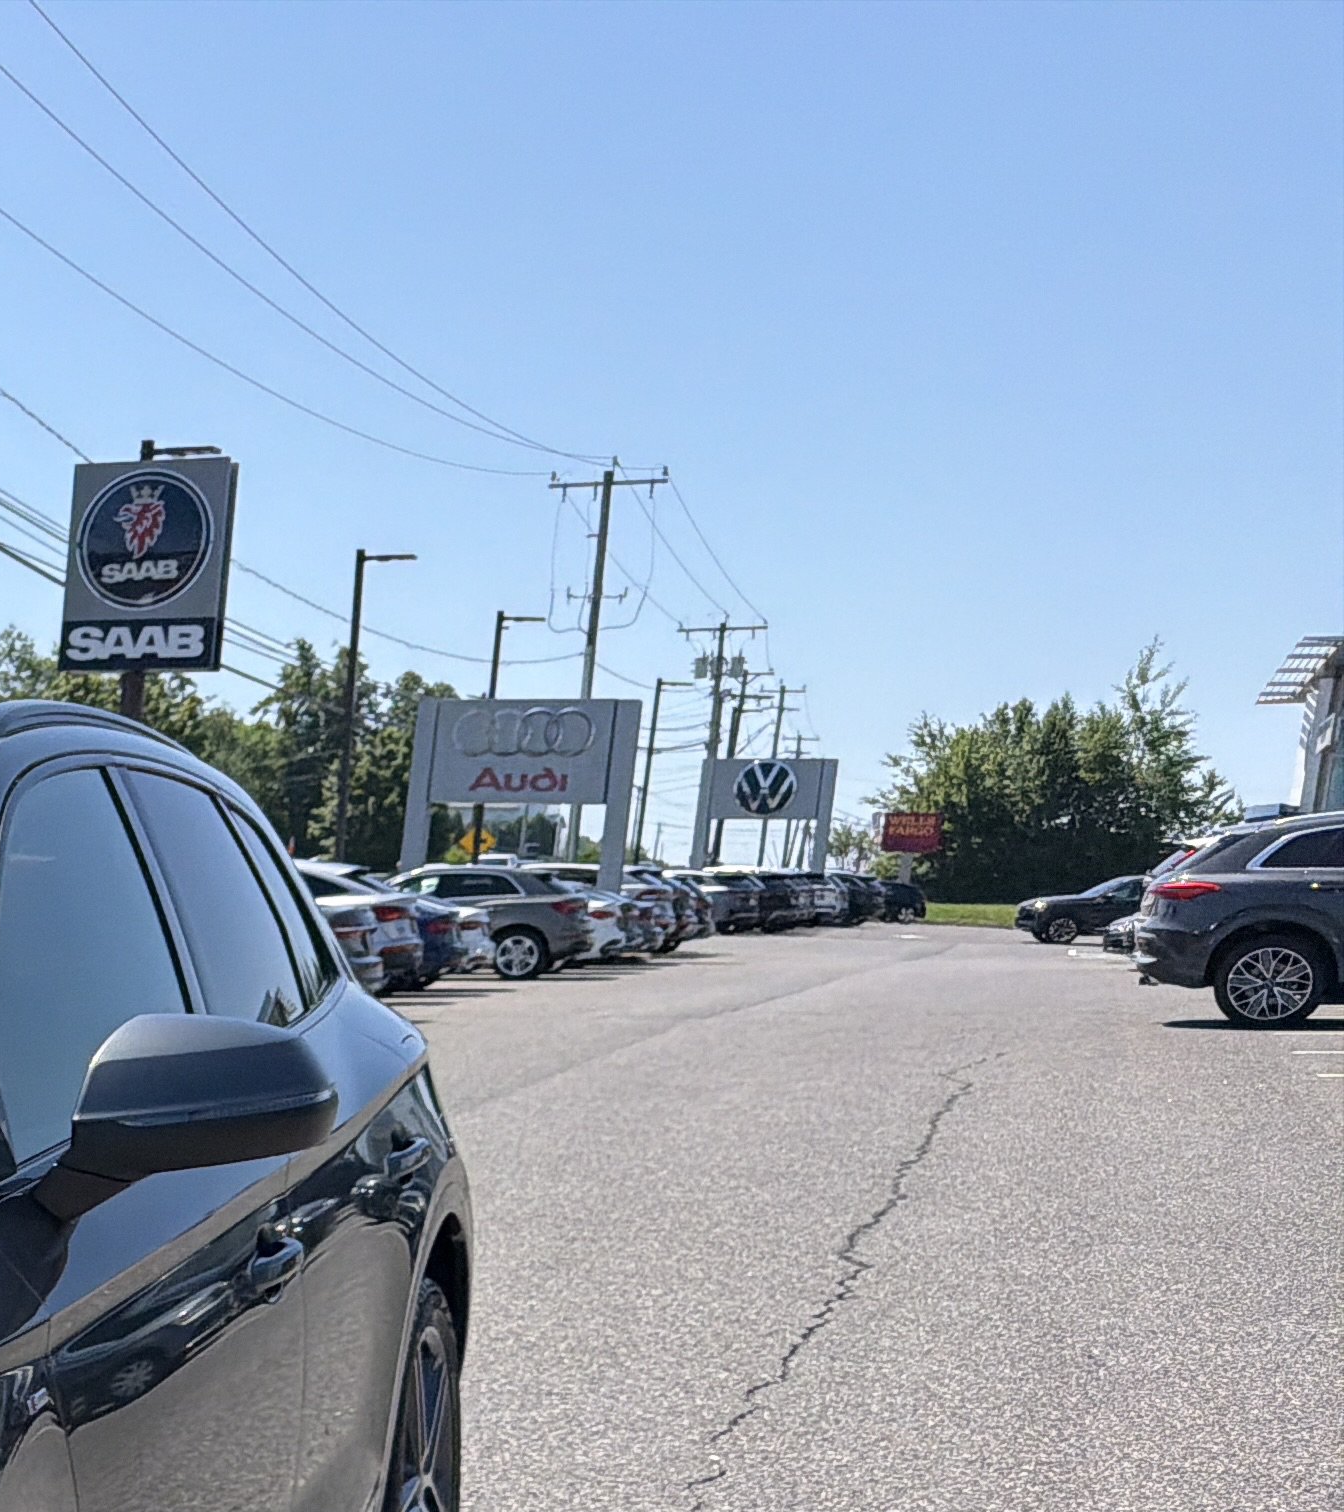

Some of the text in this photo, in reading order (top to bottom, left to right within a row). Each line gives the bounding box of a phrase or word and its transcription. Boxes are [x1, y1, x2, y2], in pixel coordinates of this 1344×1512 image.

[100, 559, 179, 584] SAAB
[65, 625, 205, 662] SAAB
[469, 767, 568, 792] Audi
[889, 815, 936, 825] WELLS
[889, 826, 934, 836] FARGO
